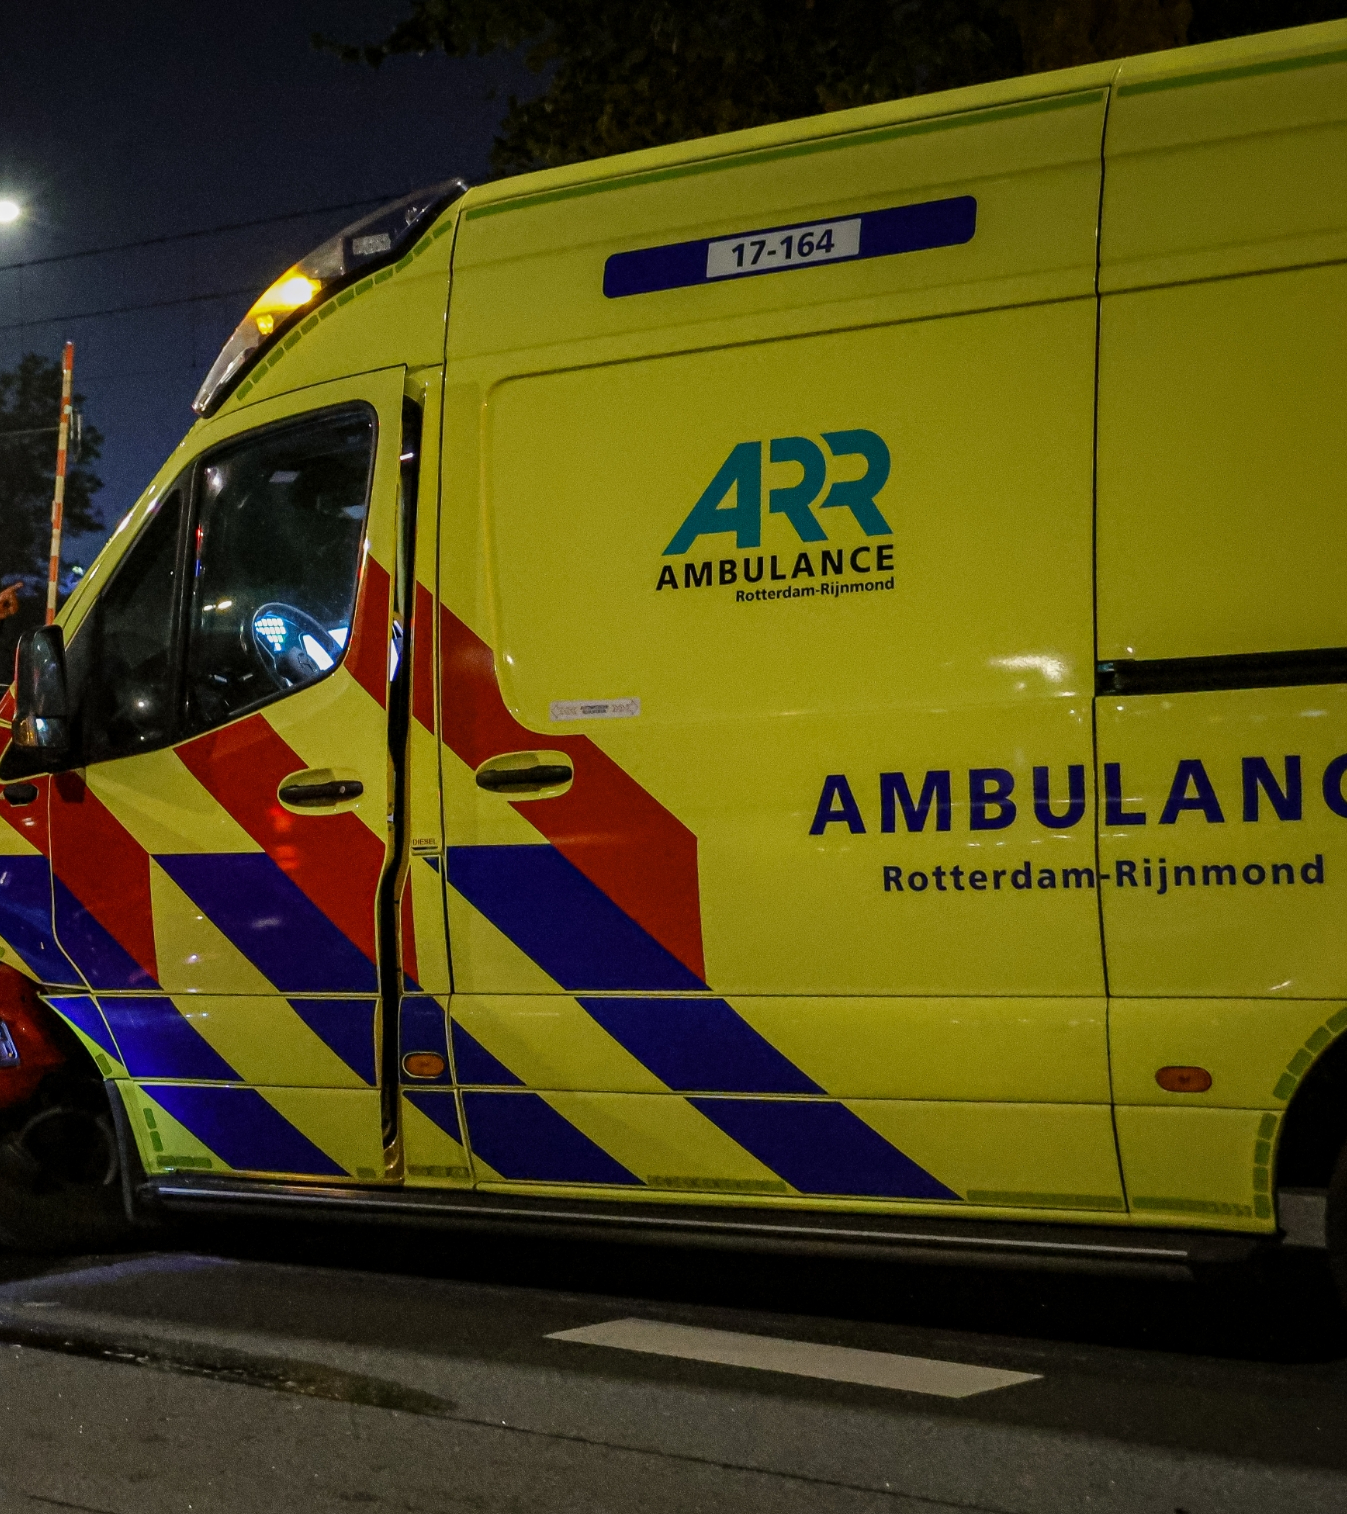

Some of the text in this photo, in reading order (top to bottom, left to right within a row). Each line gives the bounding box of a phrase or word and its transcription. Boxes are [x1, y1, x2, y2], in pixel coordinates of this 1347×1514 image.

[731, 229, 835, 267] 17-164
[661, 428, 894, 556] ARR
[656, 544, 895, 591] AMBULANCE
[736, 577, 895, 602] Rotterdam-Rijnmond
[412, 838, 437, 846] DIESEL
[883, 854, 1325, 894] Rotterdam-Rijnmond
